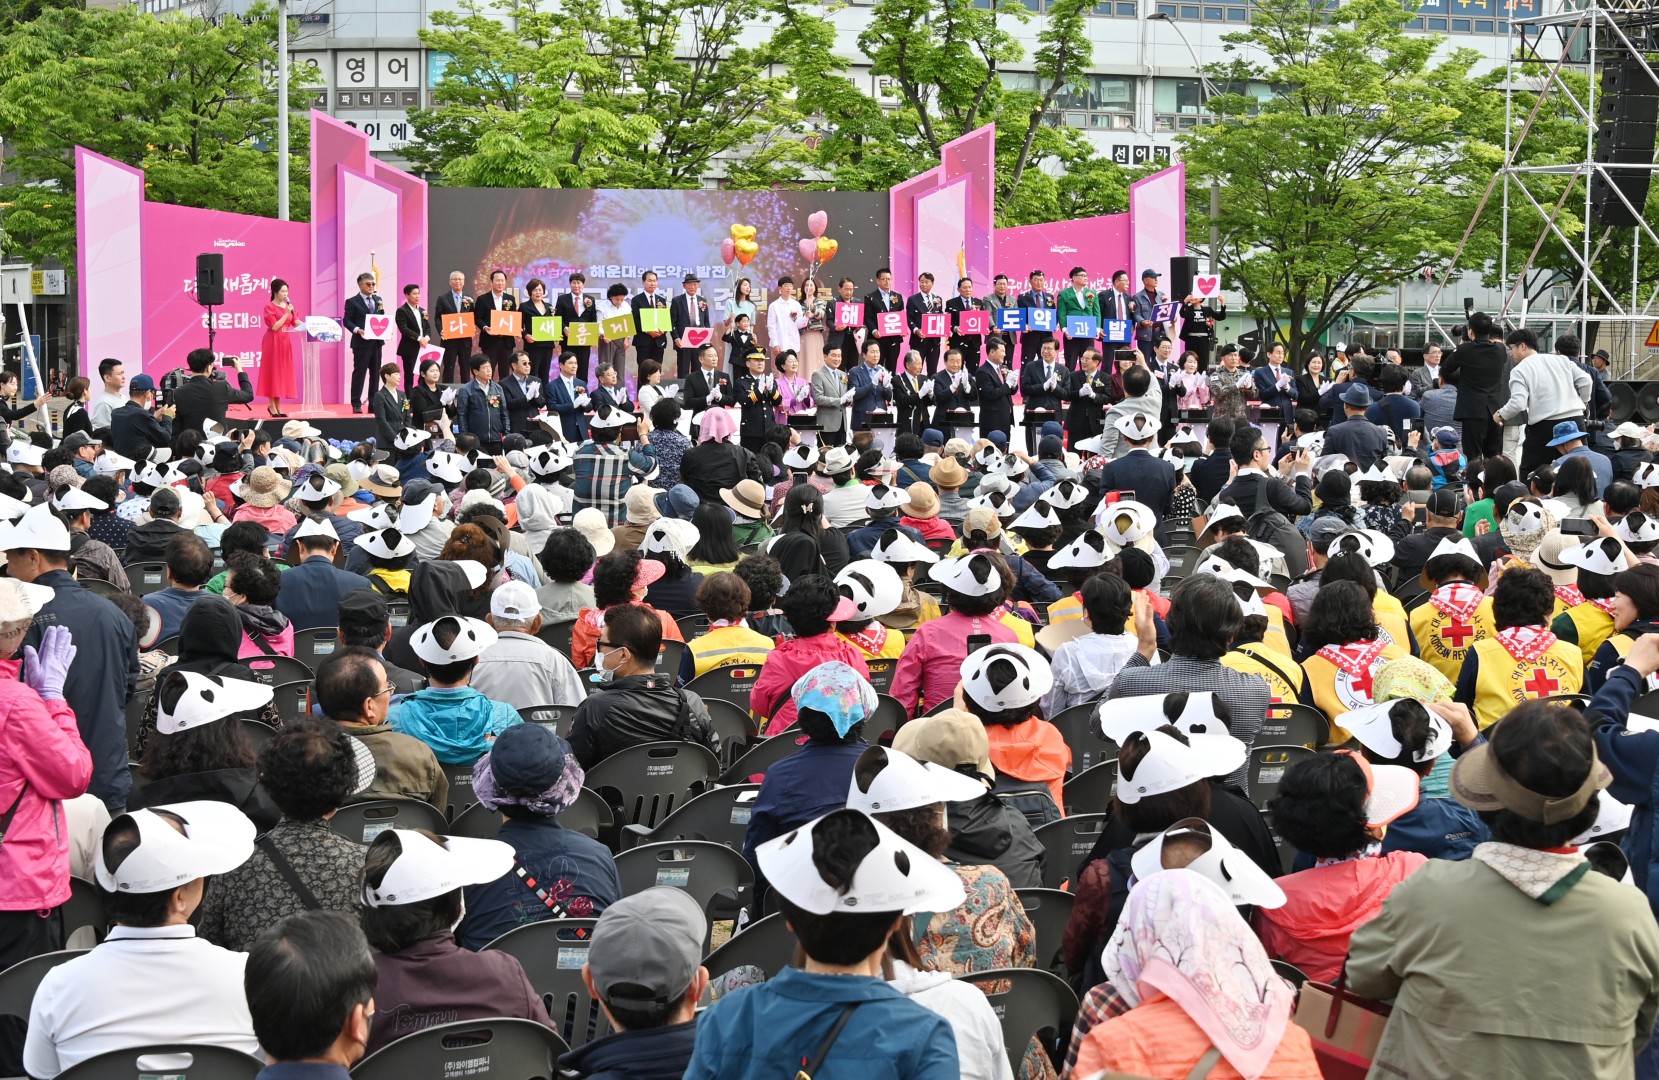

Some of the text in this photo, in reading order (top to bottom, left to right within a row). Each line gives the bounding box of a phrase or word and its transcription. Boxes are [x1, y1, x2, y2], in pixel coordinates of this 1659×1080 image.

[590, 265, 649, 278] 해운대의
[652, 265, 695, 278] 도약과
[696, 265, 727, 279] 발전
[202, 313, 261, 329] 해운대의
[498, 314, 514, 332] 시
[841, 305, 859, 325] 해
[1002, 310, 1020, 329] 도
[1033, 309, 1052, 330] 약
[1155, 304, 1172, 323] 전
[449, 316, 468, 335] 다
[539, 322, 555, 337] 새
[610, 319, 629, 333] 게
[883, 313, 902, 334] 운
[927, 315, 945, 335] 대
[967, 317, 981, 333] 의
[1074, 321, 1090, 337] 과
[1108, 321, 1127, 341] 발
[575, 323, 591, 346] 롭
[1429, 633, 1452, 660] KOREAN
